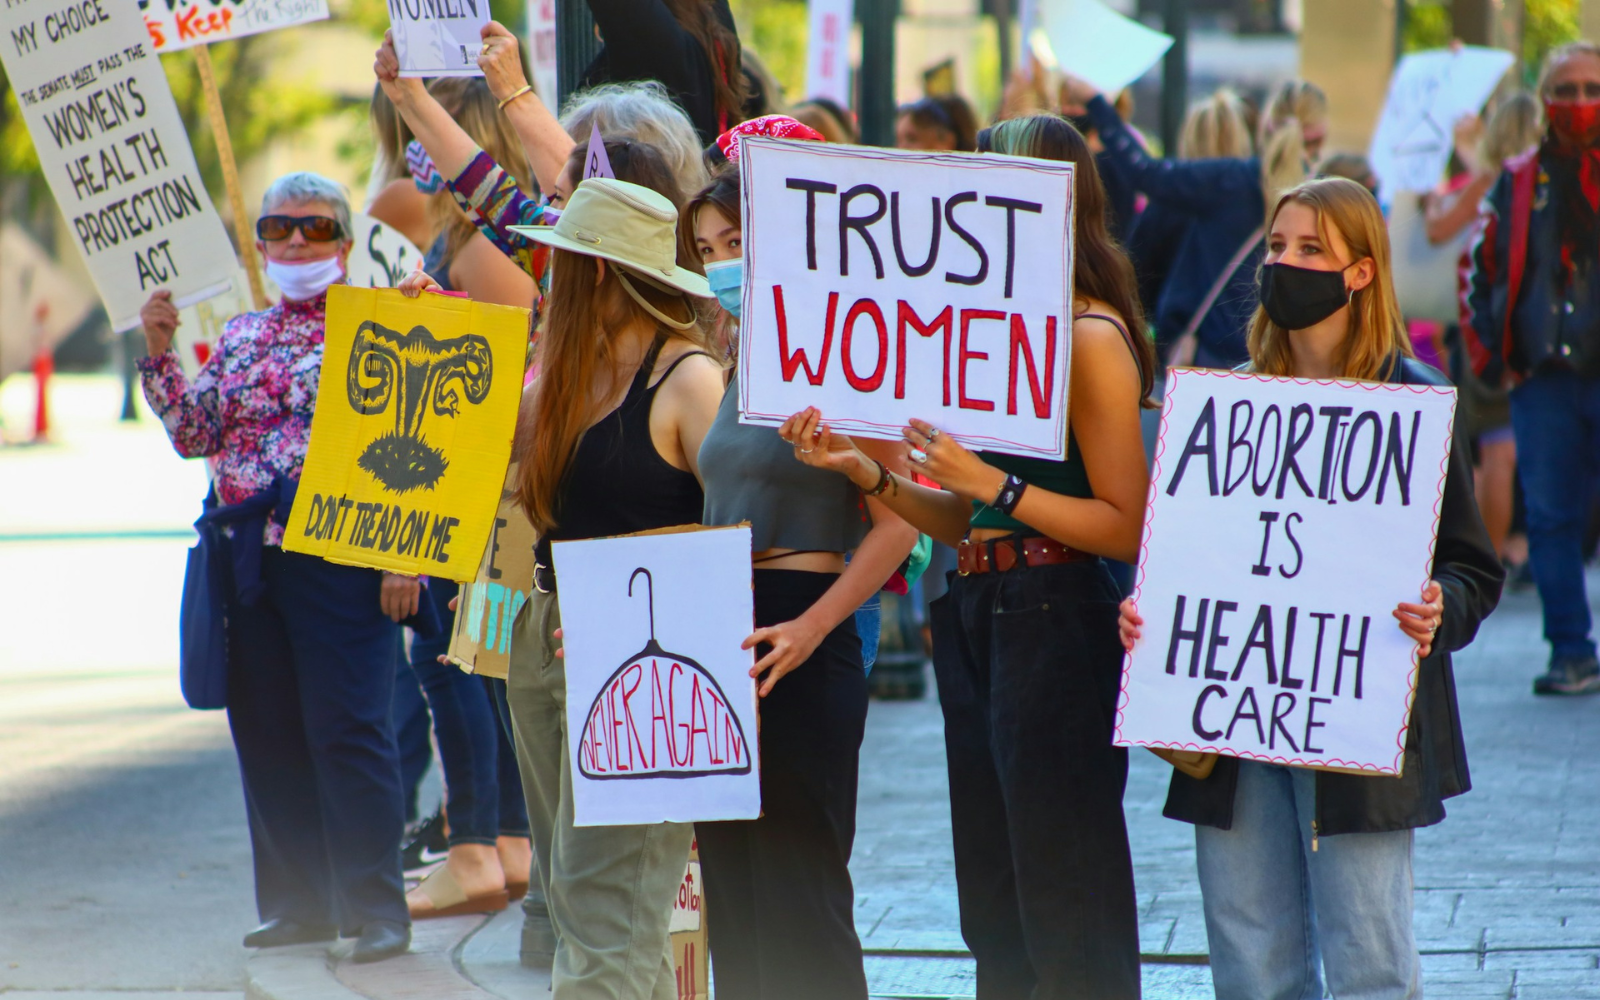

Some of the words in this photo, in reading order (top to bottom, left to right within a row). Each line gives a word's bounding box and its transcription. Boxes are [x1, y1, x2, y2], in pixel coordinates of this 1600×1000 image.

[10, 21, 38, 58] MY
[44, 0, 110, 43] CHOICE
[175, 5, 233, 42] Keep
[21, 88, 38, 107] THE
[38, 75, 71, 101] SENATE
[70, 64, 97, 90] MUST
[97, 53, 122, 74] PASS
[123, 43, 146, 62] THE
[43, 77, 146, 149] WOMEN'S
[65, 128, 168, 200] HEALTH
[73, 174, 202, 255] PROTECTION
[785, 178, 1042, 298] TRUST
[134, 239, 179, 291] ACT
[772, 284, 1057, 419] WOMEN
[1166, 396, 1422, 505] ABORTION
[304, 493, 354, 542] DON'T
[348, 502, 402, 552] TREAD
[397, 509, 430, 558] ON
[424, 514, 460, 563] ME
[1251, 511, 1304, 579] IS
[1165, 595, 1371, 699] HEALTH
[584, 664, 648, 772] NEVER
[652, 659, 740, 768] AGAIN
[1192, 684, 1332, 753] CARE
